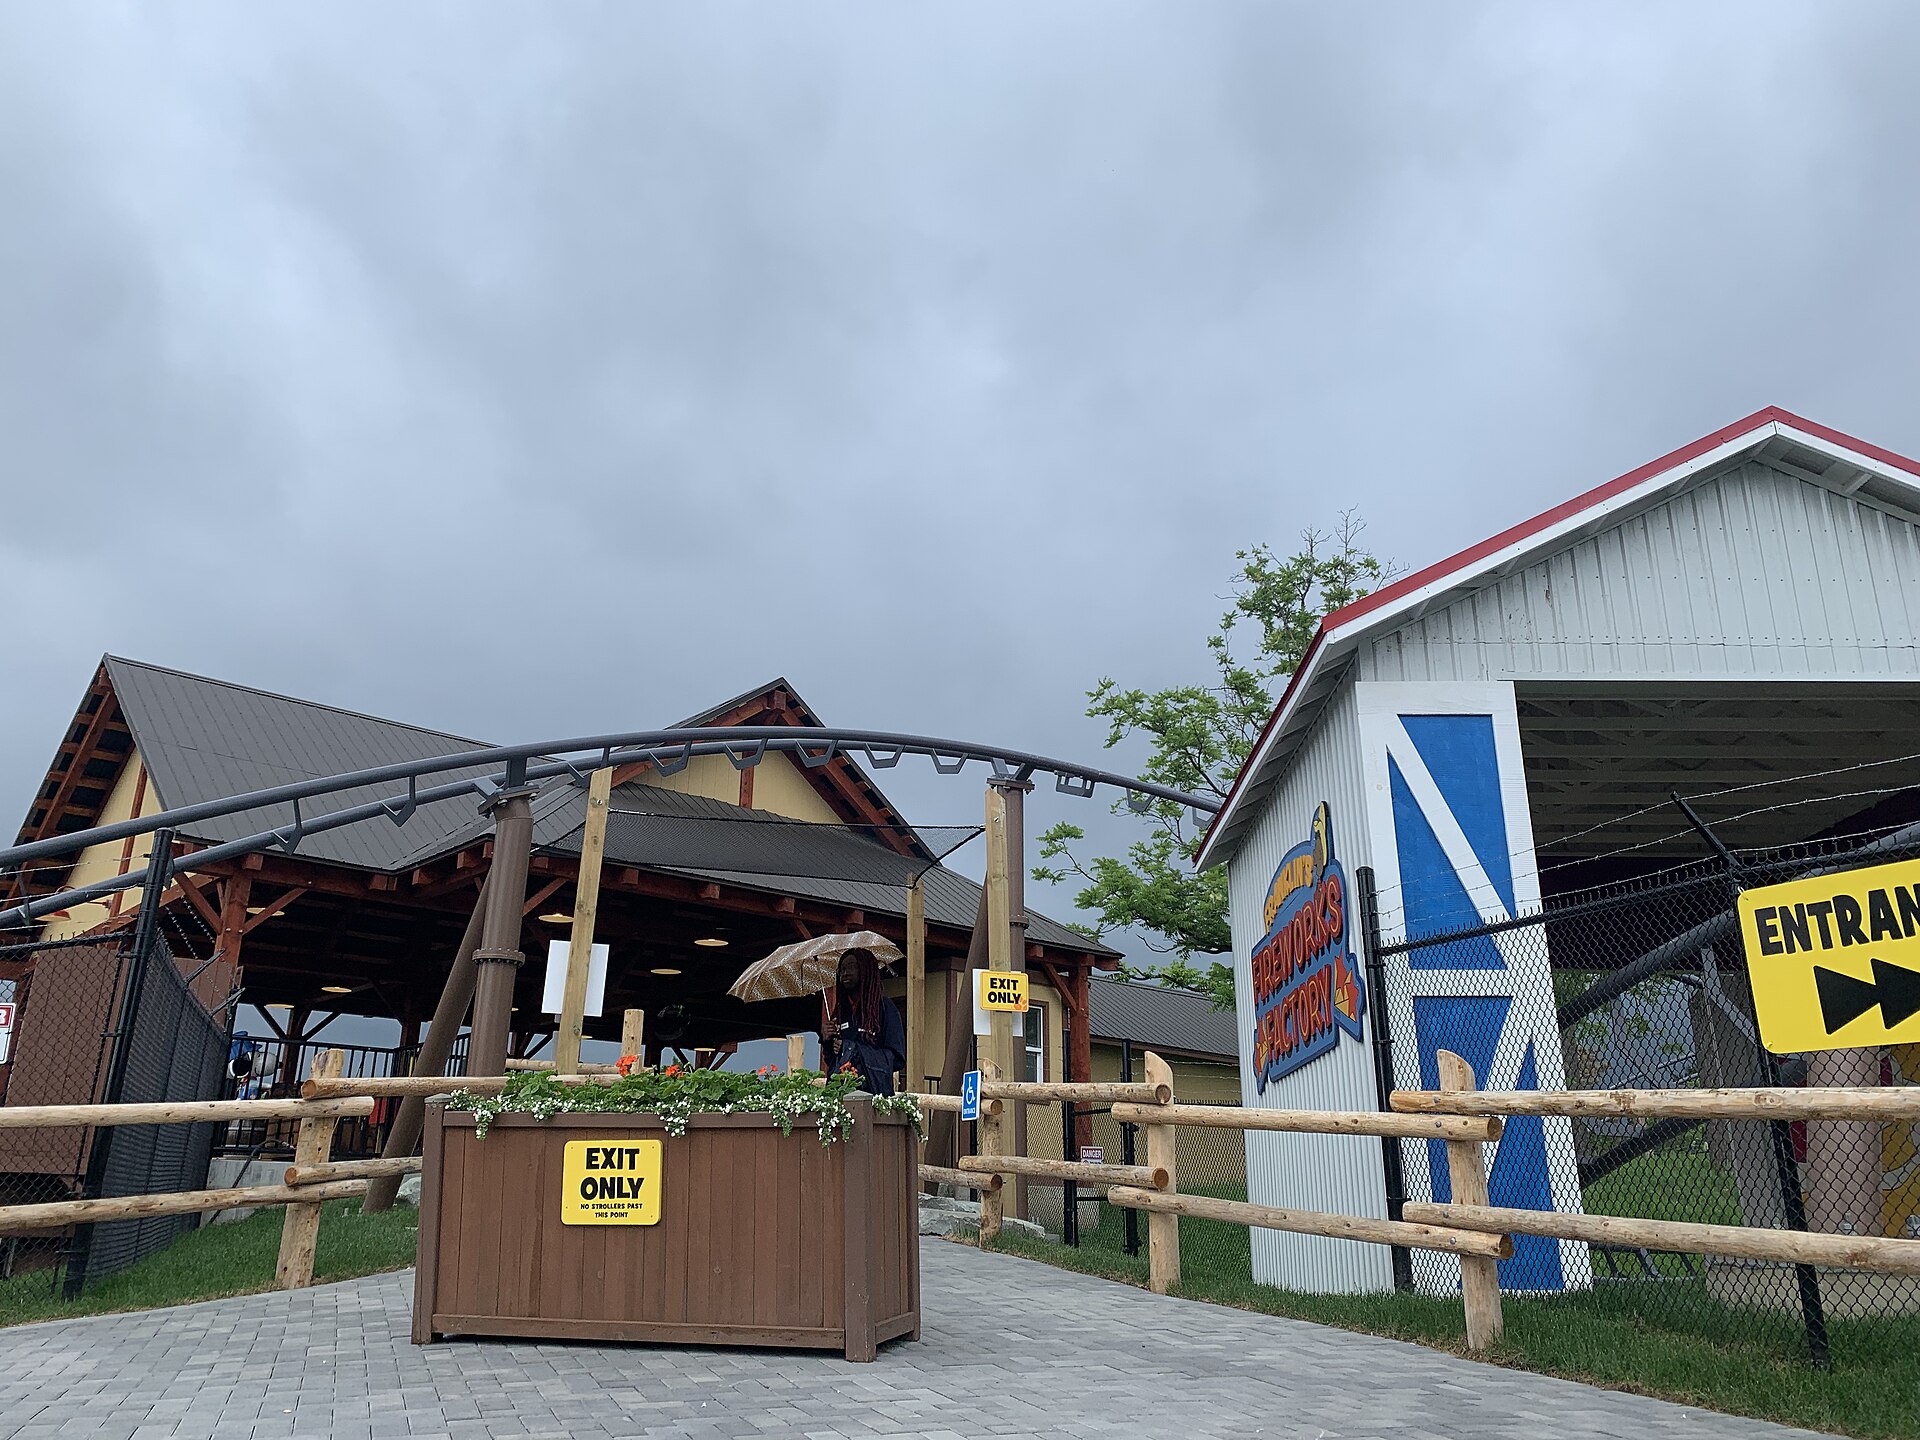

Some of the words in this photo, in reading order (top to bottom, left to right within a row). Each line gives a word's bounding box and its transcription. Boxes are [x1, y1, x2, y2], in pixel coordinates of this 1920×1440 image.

[1754, 883, 1920, 957] ENTRAN
[1252, 874, 1342, 1006] FIREWORKS
[990, 977, 1019, 991] EXIT
[987, 991, 1021, 1004] ONLY
[1266, 963, 1332, 1067] FACTORY
[586, 1147, 640, 1170] EXIT
[1082, 1149, 1102, 1159] DANGER
[580, 1177, 645, 1201] ONLY
[591, 1202, 626, 1210] STROLLERS
[627, 1202, 643, 1210] PAST
